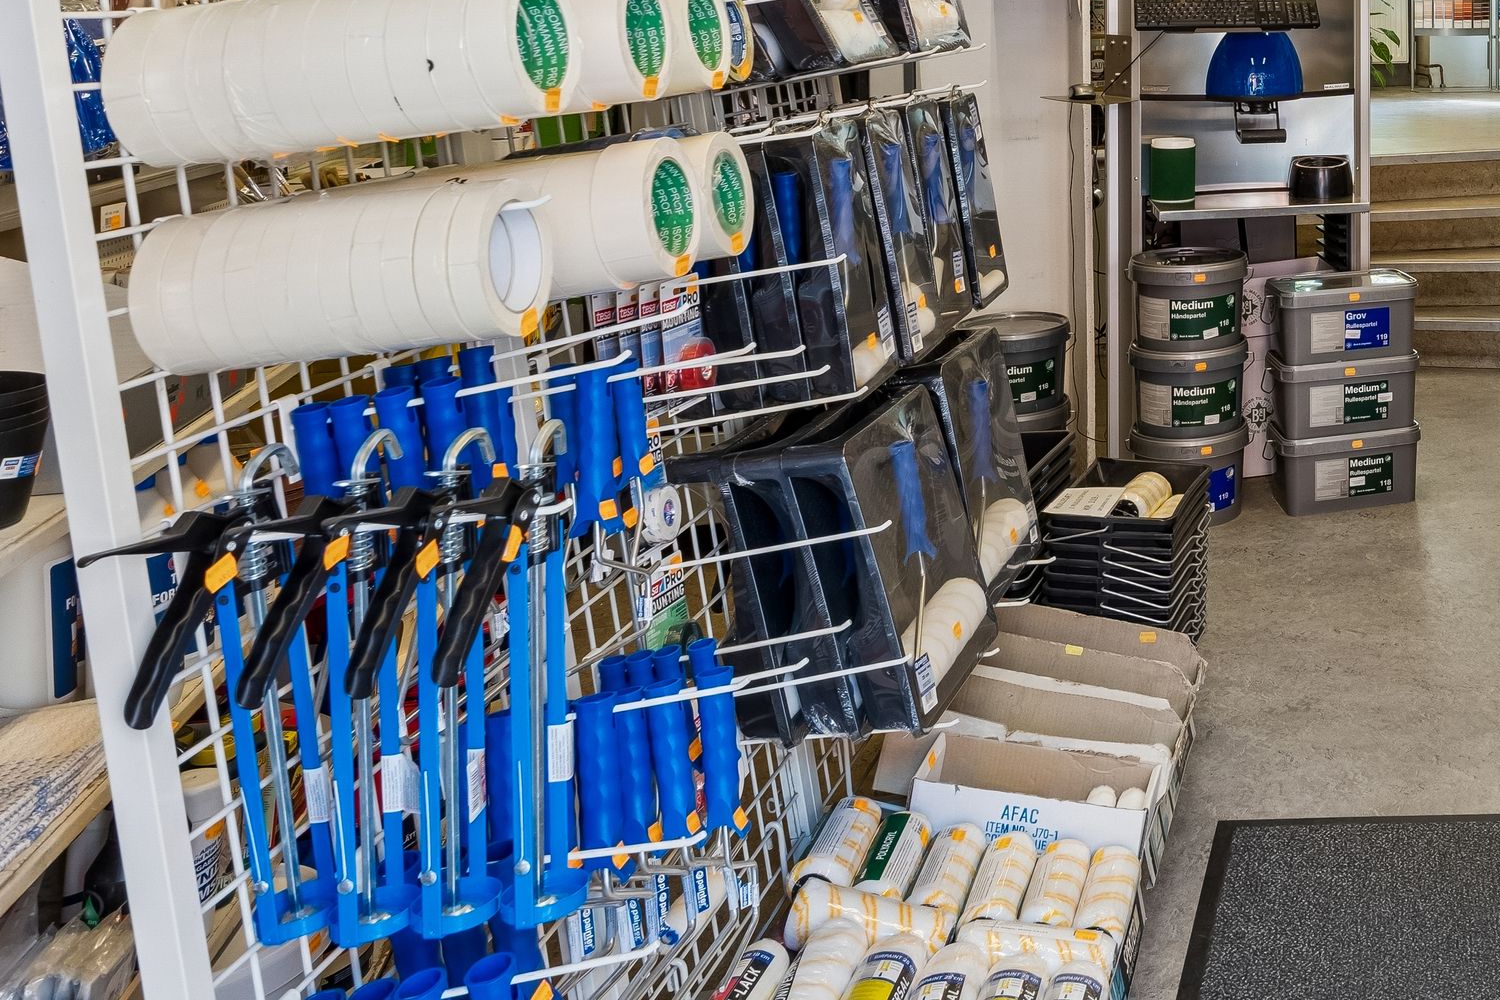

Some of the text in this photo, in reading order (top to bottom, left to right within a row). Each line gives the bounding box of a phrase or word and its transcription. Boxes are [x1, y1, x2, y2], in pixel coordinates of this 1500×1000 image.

[682, 291, 699, 306] PRO
[641, 303, 658, 315] tesa
[662, 300, 679, 313] tesa
[1171, 299, 1214, 311] Medium
[595, 309, 613, 322] tesa
[618, 306, 636, 319] tesa
[1171, 311, 1207, 320] Håndspartel
[1345, 311, 1367, 321] Grov
[1219, 318, 1230, 327] 118
[1376, 333, 1388, 341] 119
[1038, 382, 1049, 391] 118
[1173, 386, 1216, 397] Medium
[1344, 383, 1380, 395] Medium
[1173, 398, 1209, 406] Håndspartel
[1344, 394, 1377, 403] Rullespartel
[1220, 403, 1231, 413] 118
[1375, 406, 1387, 414] 118
[1251, 407, 1266, 423] B&J
[1349, 456, 1385, 468] Medium
[1349, 467, 1382, 476] Rullespartel
[1379, 478, 1392, 487] 118
[1218, 491, 1229, 501] 119
[665, 571, 682, 589] PRO
[1001, 804, 1040, 824] AFAC
[985, 821, 1010, 834] ITEM
[1032, 827, 1059, 840] J70-1
[875, 830, 898, 861] POLYACRYL
